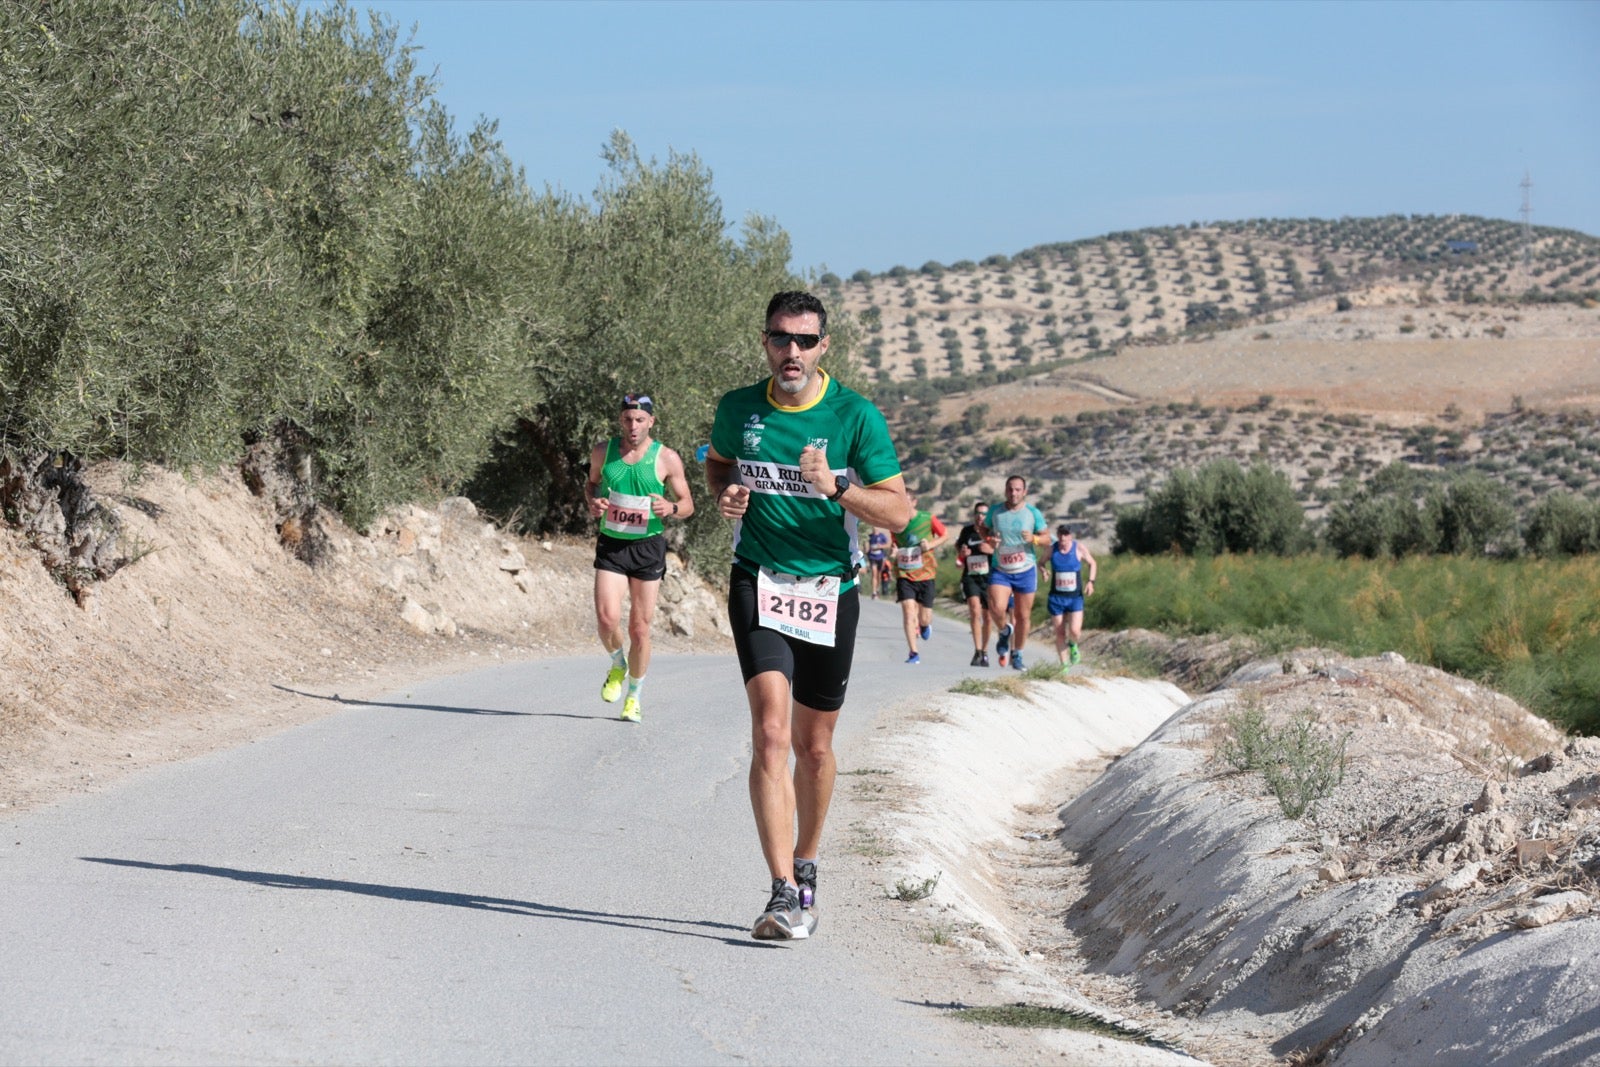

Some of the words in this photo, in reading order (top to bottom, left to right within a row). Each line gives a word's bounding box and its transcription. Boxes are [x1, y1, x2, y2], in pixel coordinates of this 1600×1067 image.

[740, 464, 772, 479] CAJA
[755, 480, 809, 493] GRANADA
[612, 509, 643, 525] 1041
[770, 595, 828, 624] 2182
[780, 624, 794, 635] JOSE
[795, 628, 811, 639] RAUL
